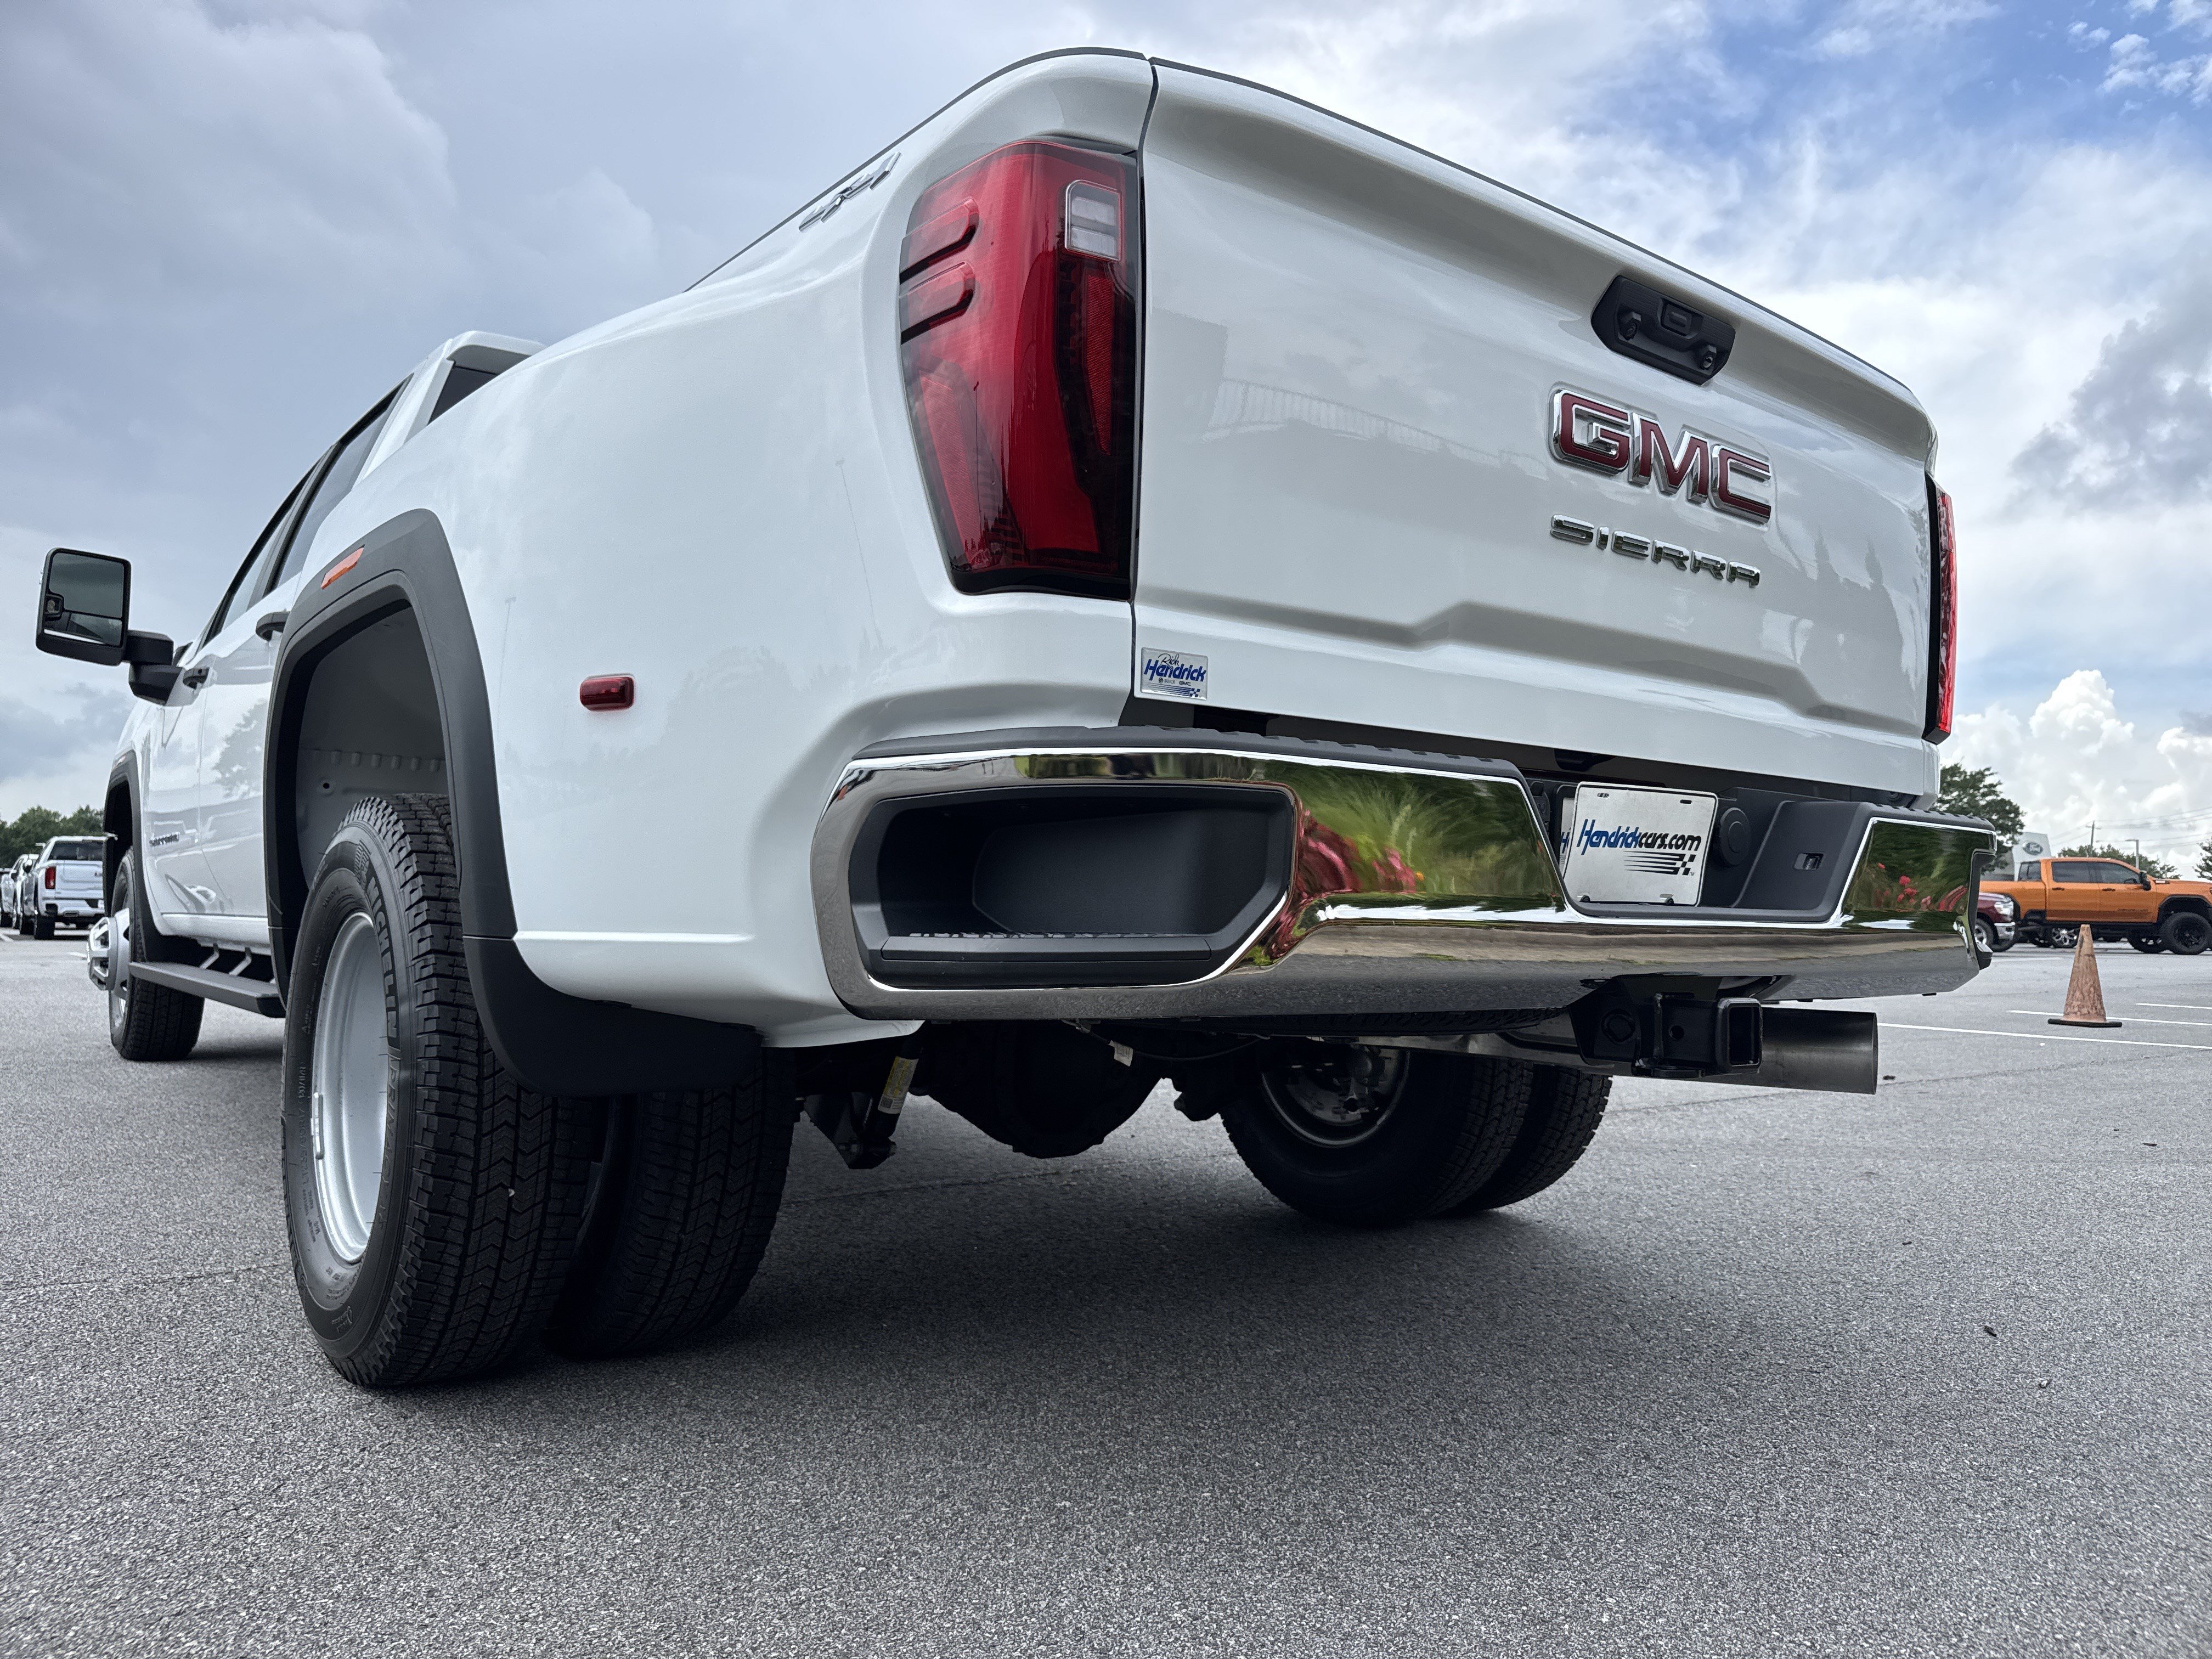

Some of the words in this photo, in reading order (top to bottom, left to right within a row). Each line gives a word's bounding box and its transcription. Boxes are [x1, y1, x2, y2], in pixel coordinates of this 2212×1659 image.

[1553, 388, 1771, 524] GMC
[1550, 514, 1760, 588] SIERRA
[1144, 659, 1206, 682] Hendrick
[1158, 653, 1180, 669] Rick
[1576, 819, 1702, 855] Hendrickcars.com
[366, 876, 398, 1038] MICHELIN
